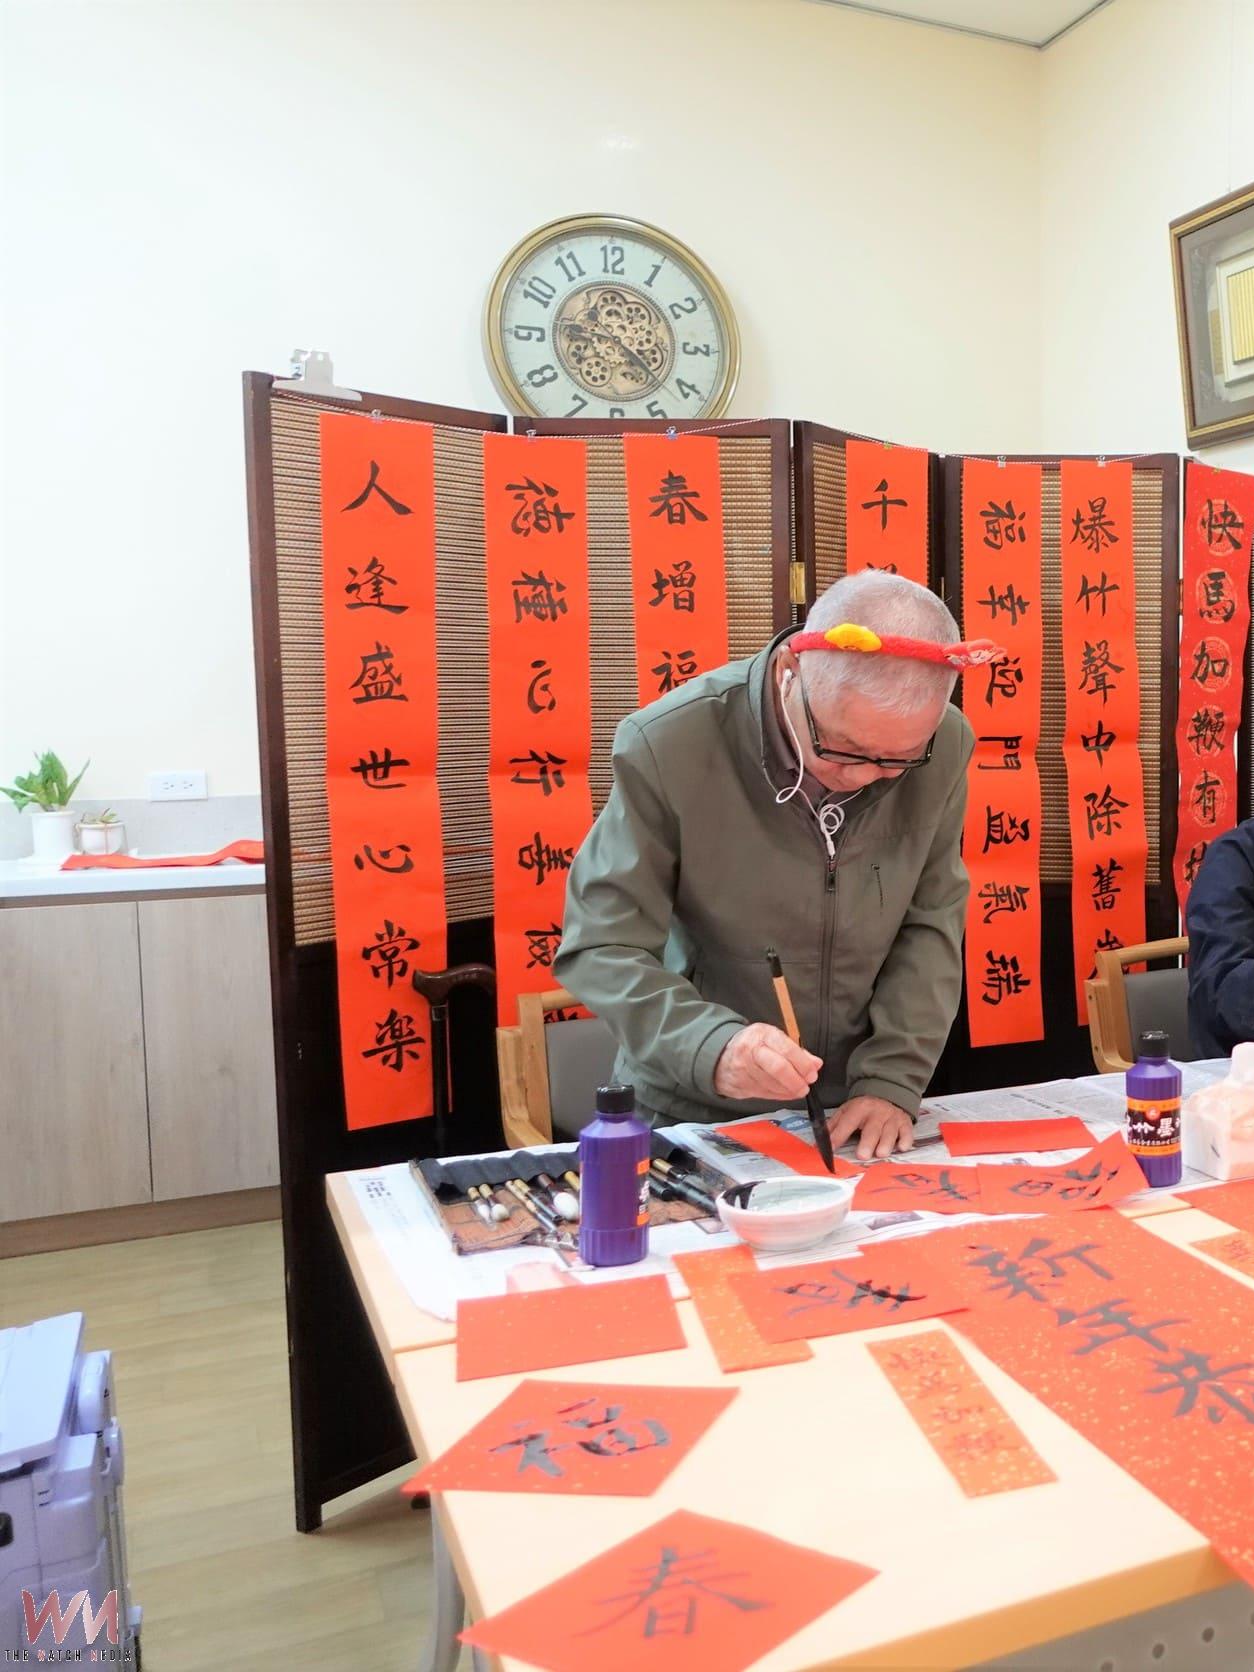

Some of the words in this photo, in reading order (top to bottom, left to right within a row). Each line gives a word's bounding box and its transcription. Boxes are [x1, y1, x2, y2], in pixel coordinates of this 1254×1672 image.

[555, 251, 586, 282] 11
[600, 245, 625, 275] 12
[644, 264, 662, 287] 1
[523, 276, 556, 308] 10
[669, 297, 698, 319] 2
[514, 325, 546, 342] 9
[682, 342, 710, 357] 3
[526, 364, 558, 388] 8
[675, 378, 700, 399] 4
[564, 394, 588, 417] 7
[861, 479, 907, 574] 千
[572, 1546, 774, 1641] 春
